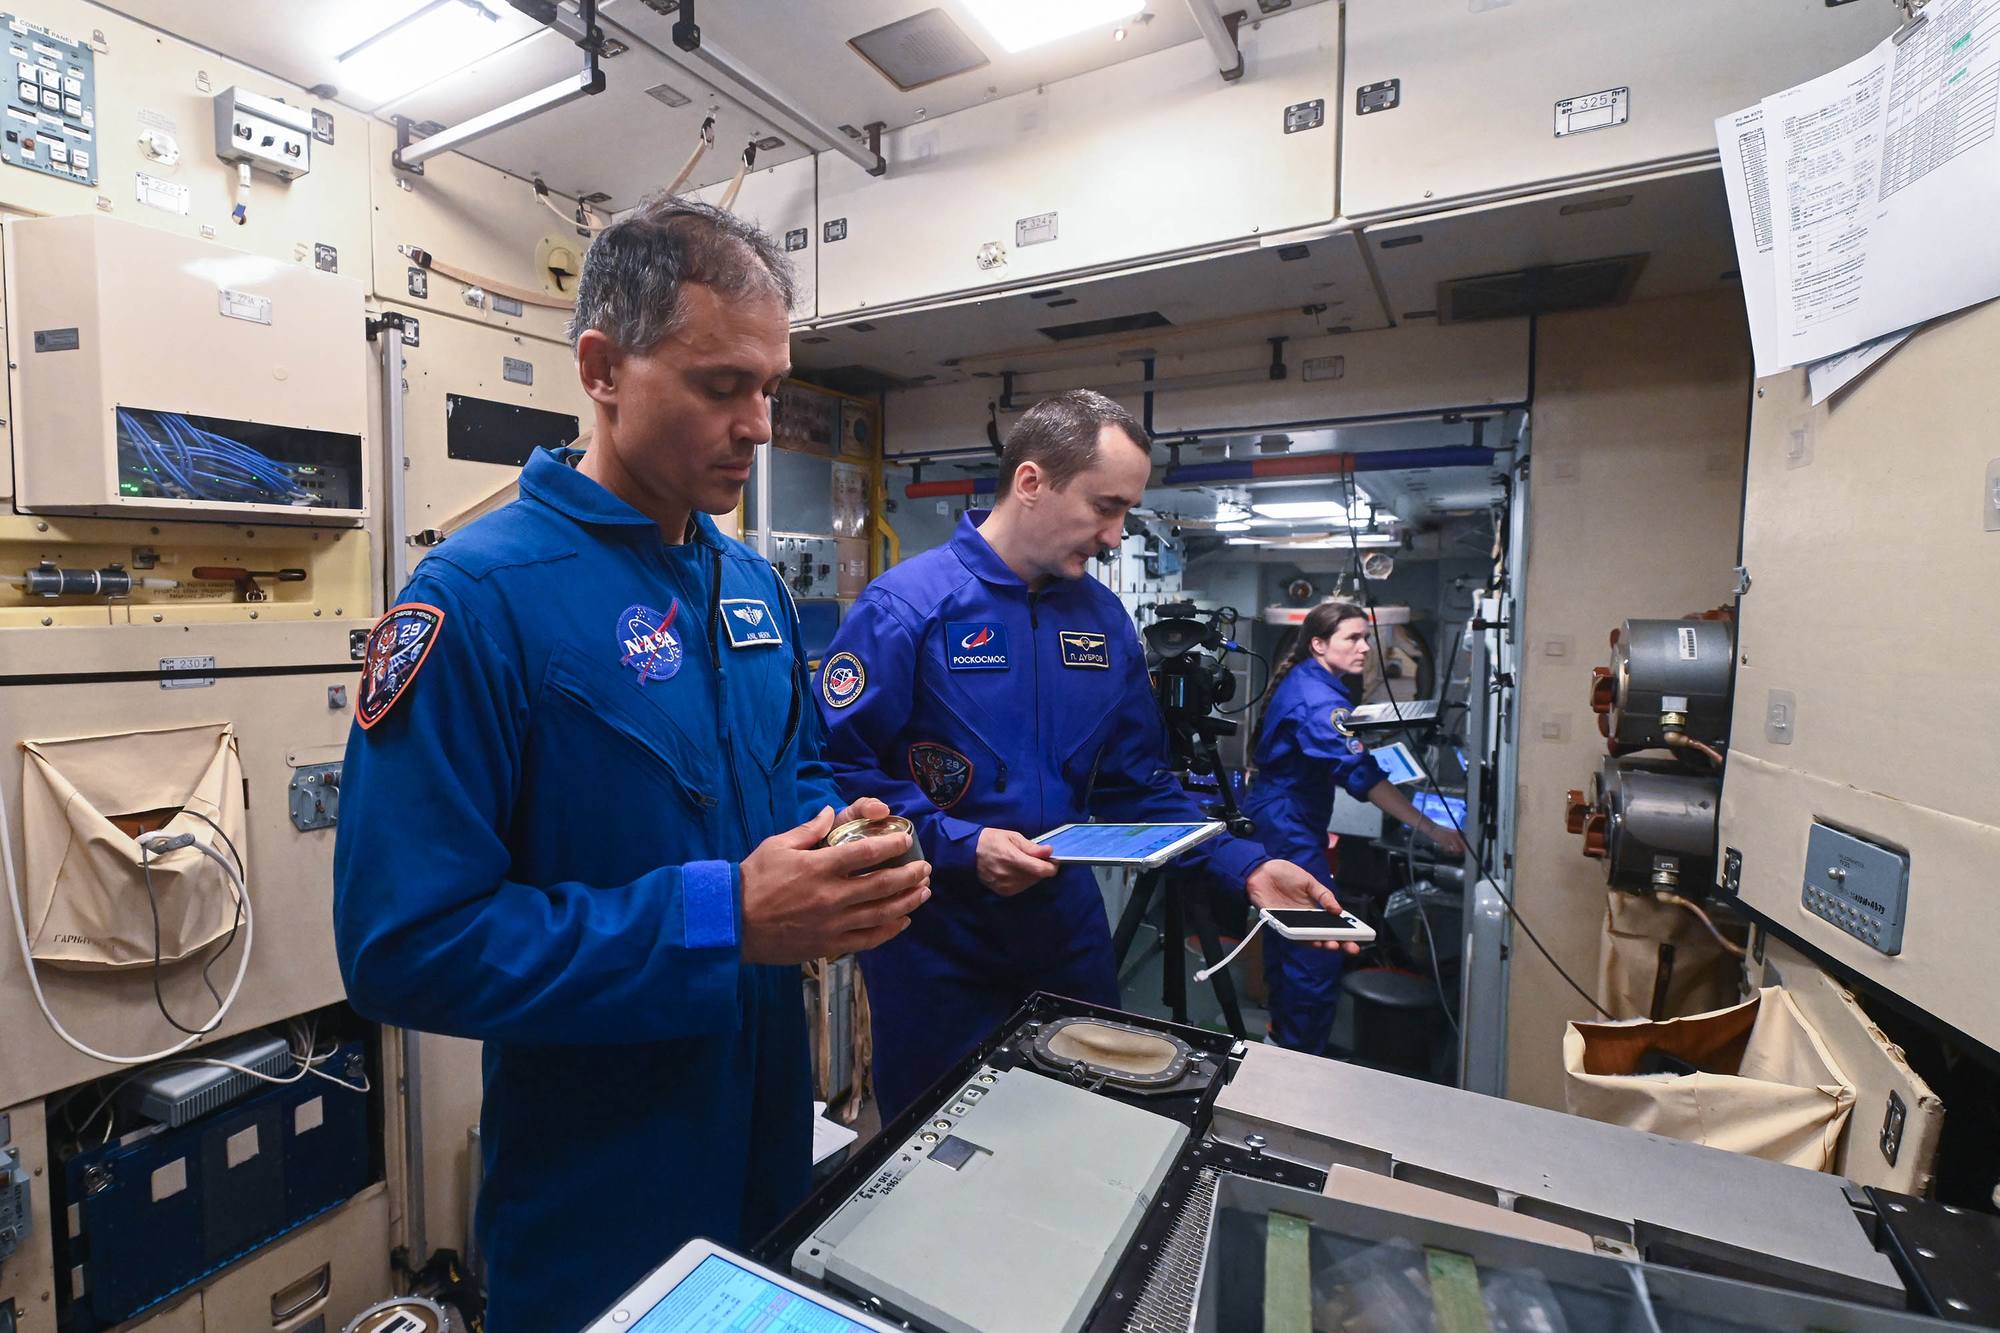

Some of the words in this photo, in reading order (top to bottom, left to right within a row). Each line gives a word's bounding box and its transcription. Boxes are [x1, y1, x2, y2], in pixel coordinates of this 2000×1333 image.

[1581, 95, 1607, 110] 325
[400, 623, 421, 638] 29
[623, 630, 678, 656] NASA
[953, 655, 1006, 664] РОСКОСМОС
[1079, 653, 1104, 662] ДУБРОВ
[180, 659, 200, 669] 230
